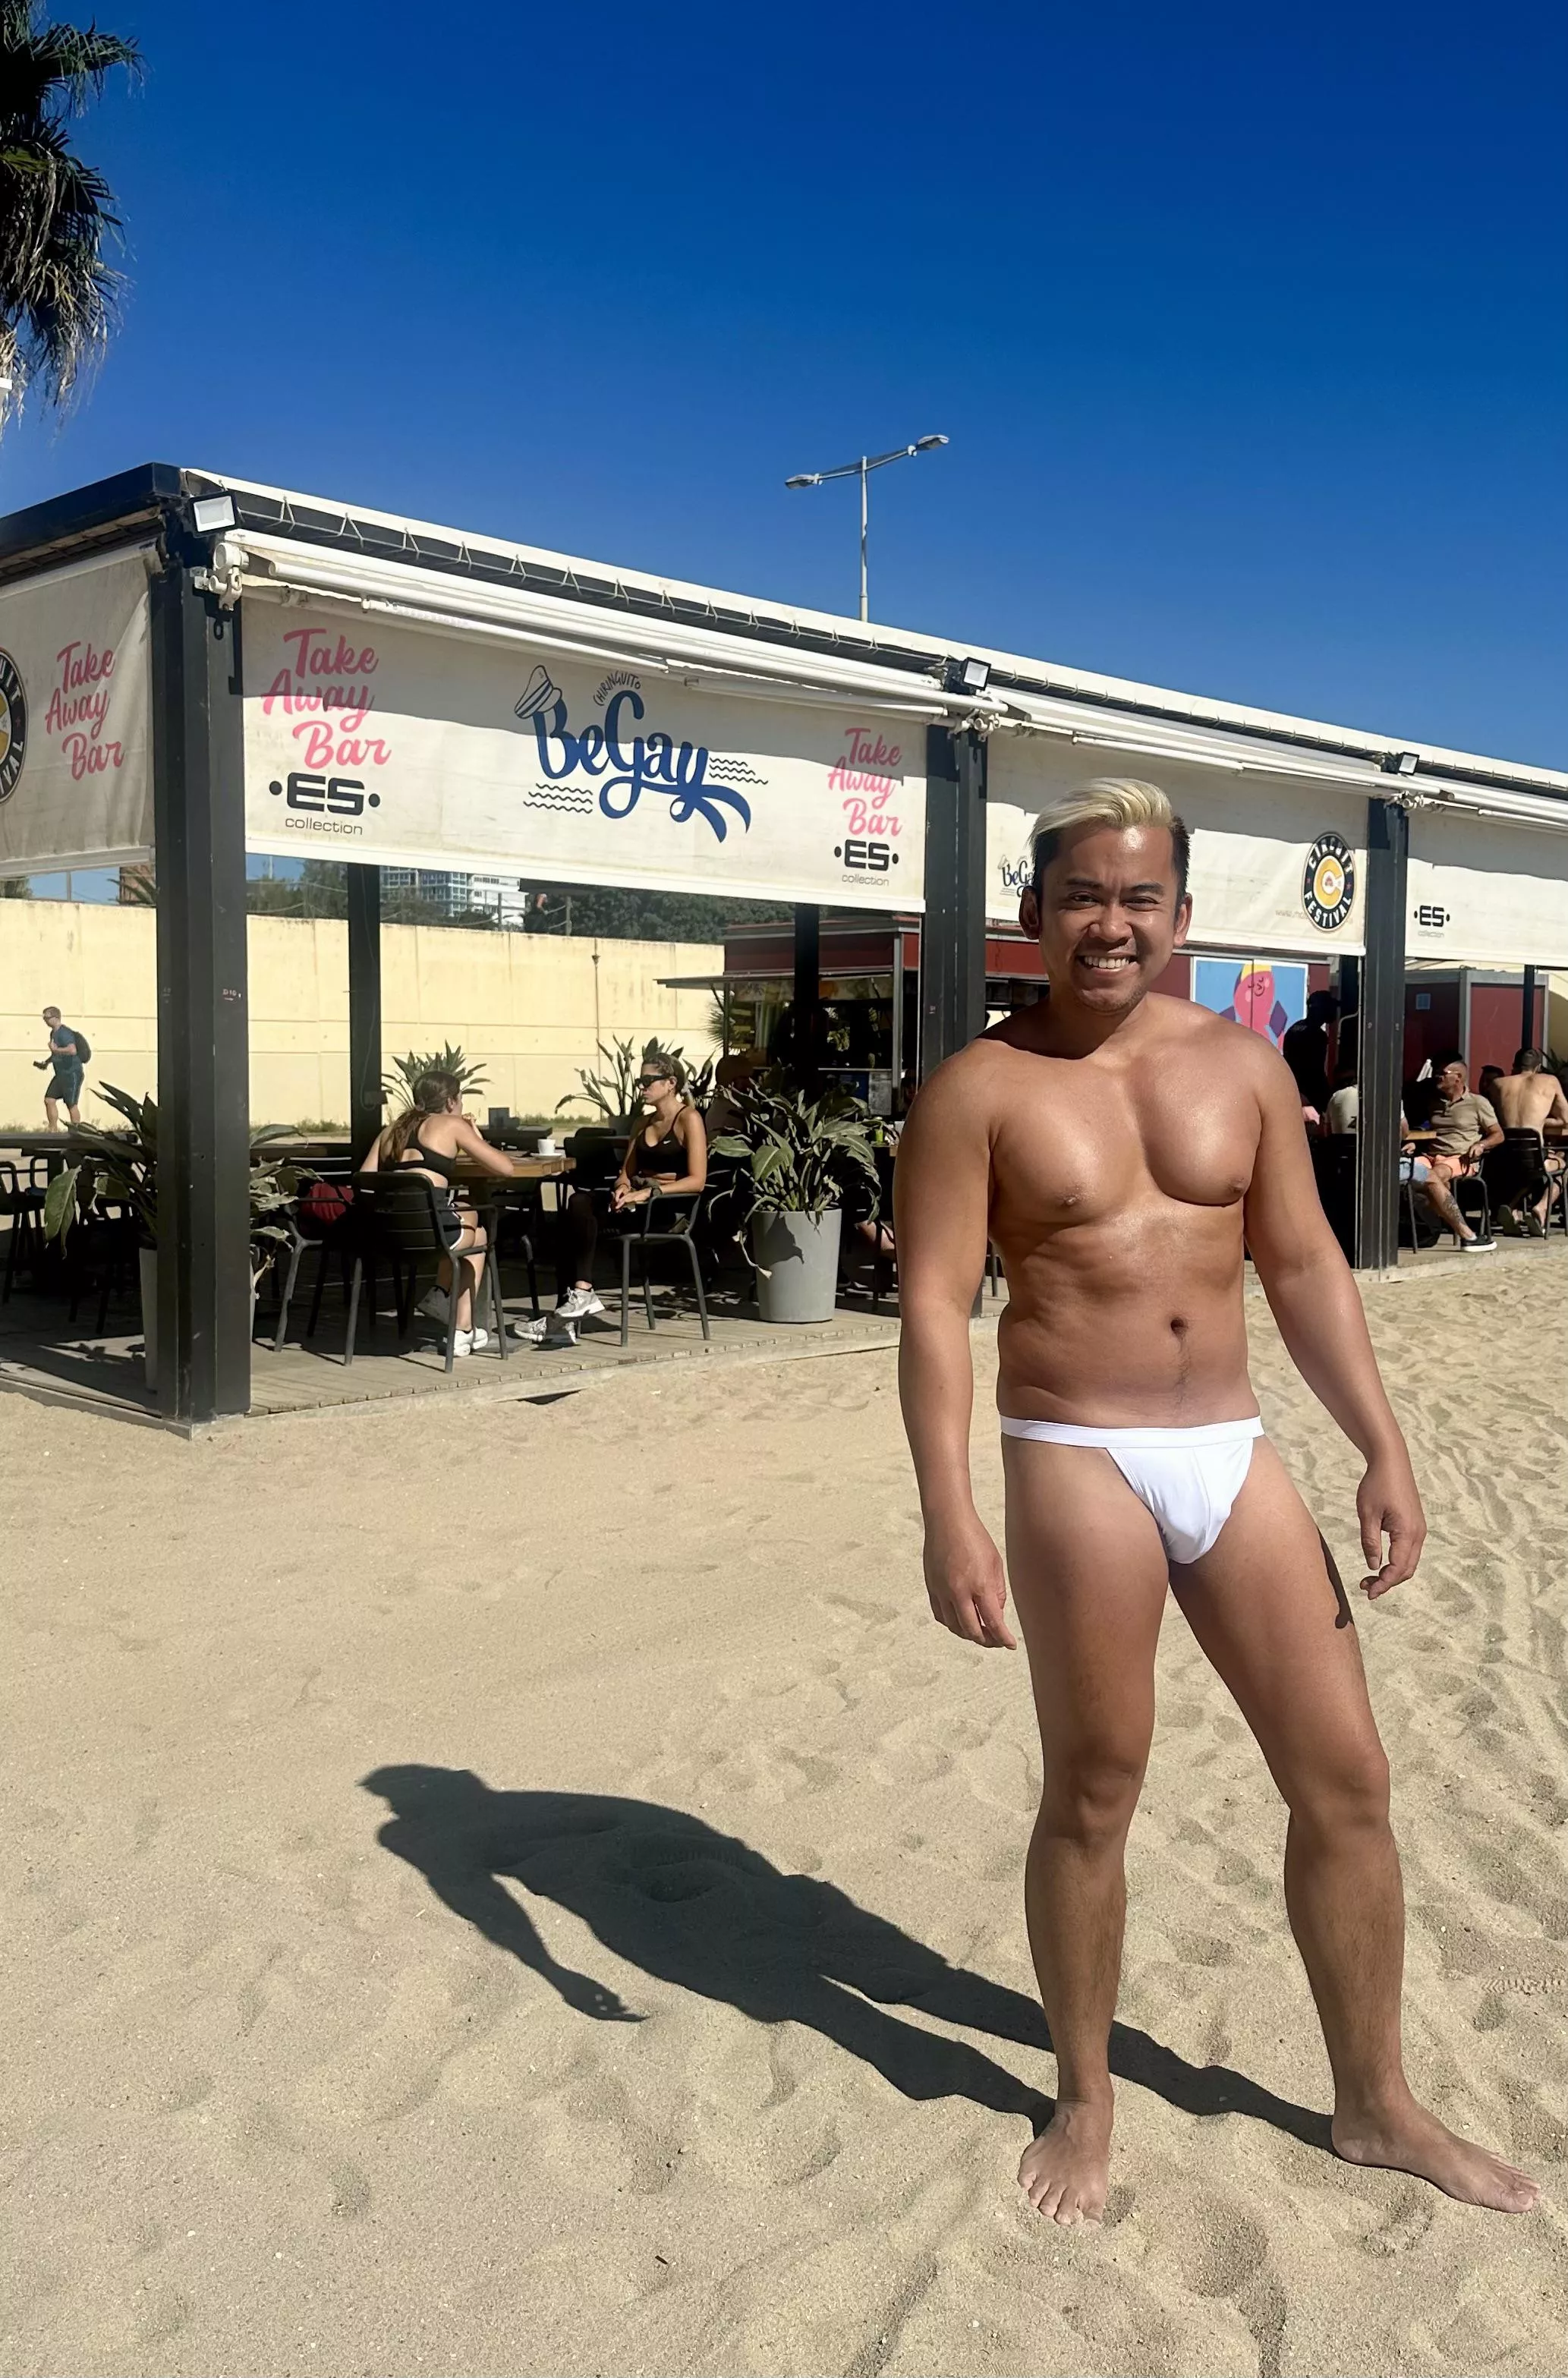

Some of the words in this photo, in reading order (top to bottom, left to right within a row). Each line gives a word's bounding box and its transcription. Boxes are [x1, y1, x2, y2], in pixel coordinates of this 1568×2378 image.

[57, 641, 115, 694] Take
[283, 628, 379, 678] Take
[45, 688, 111, 740] Away
[261, 669, 375, 732] Away
[62, 732, 125, 780] Bar
[292, 720, 392, 769] Bar
[845, 727, 902, 767] Take
[827, 755, 896, 809] Away
[285, 817, 363, 835] collection
[842, 798, 902, 836] Bar
[842, 874, 889, 886] collection
[1002, 860, 1034, 897] BeGa
[1304, 890, 1352, 928] FESTIVAL
